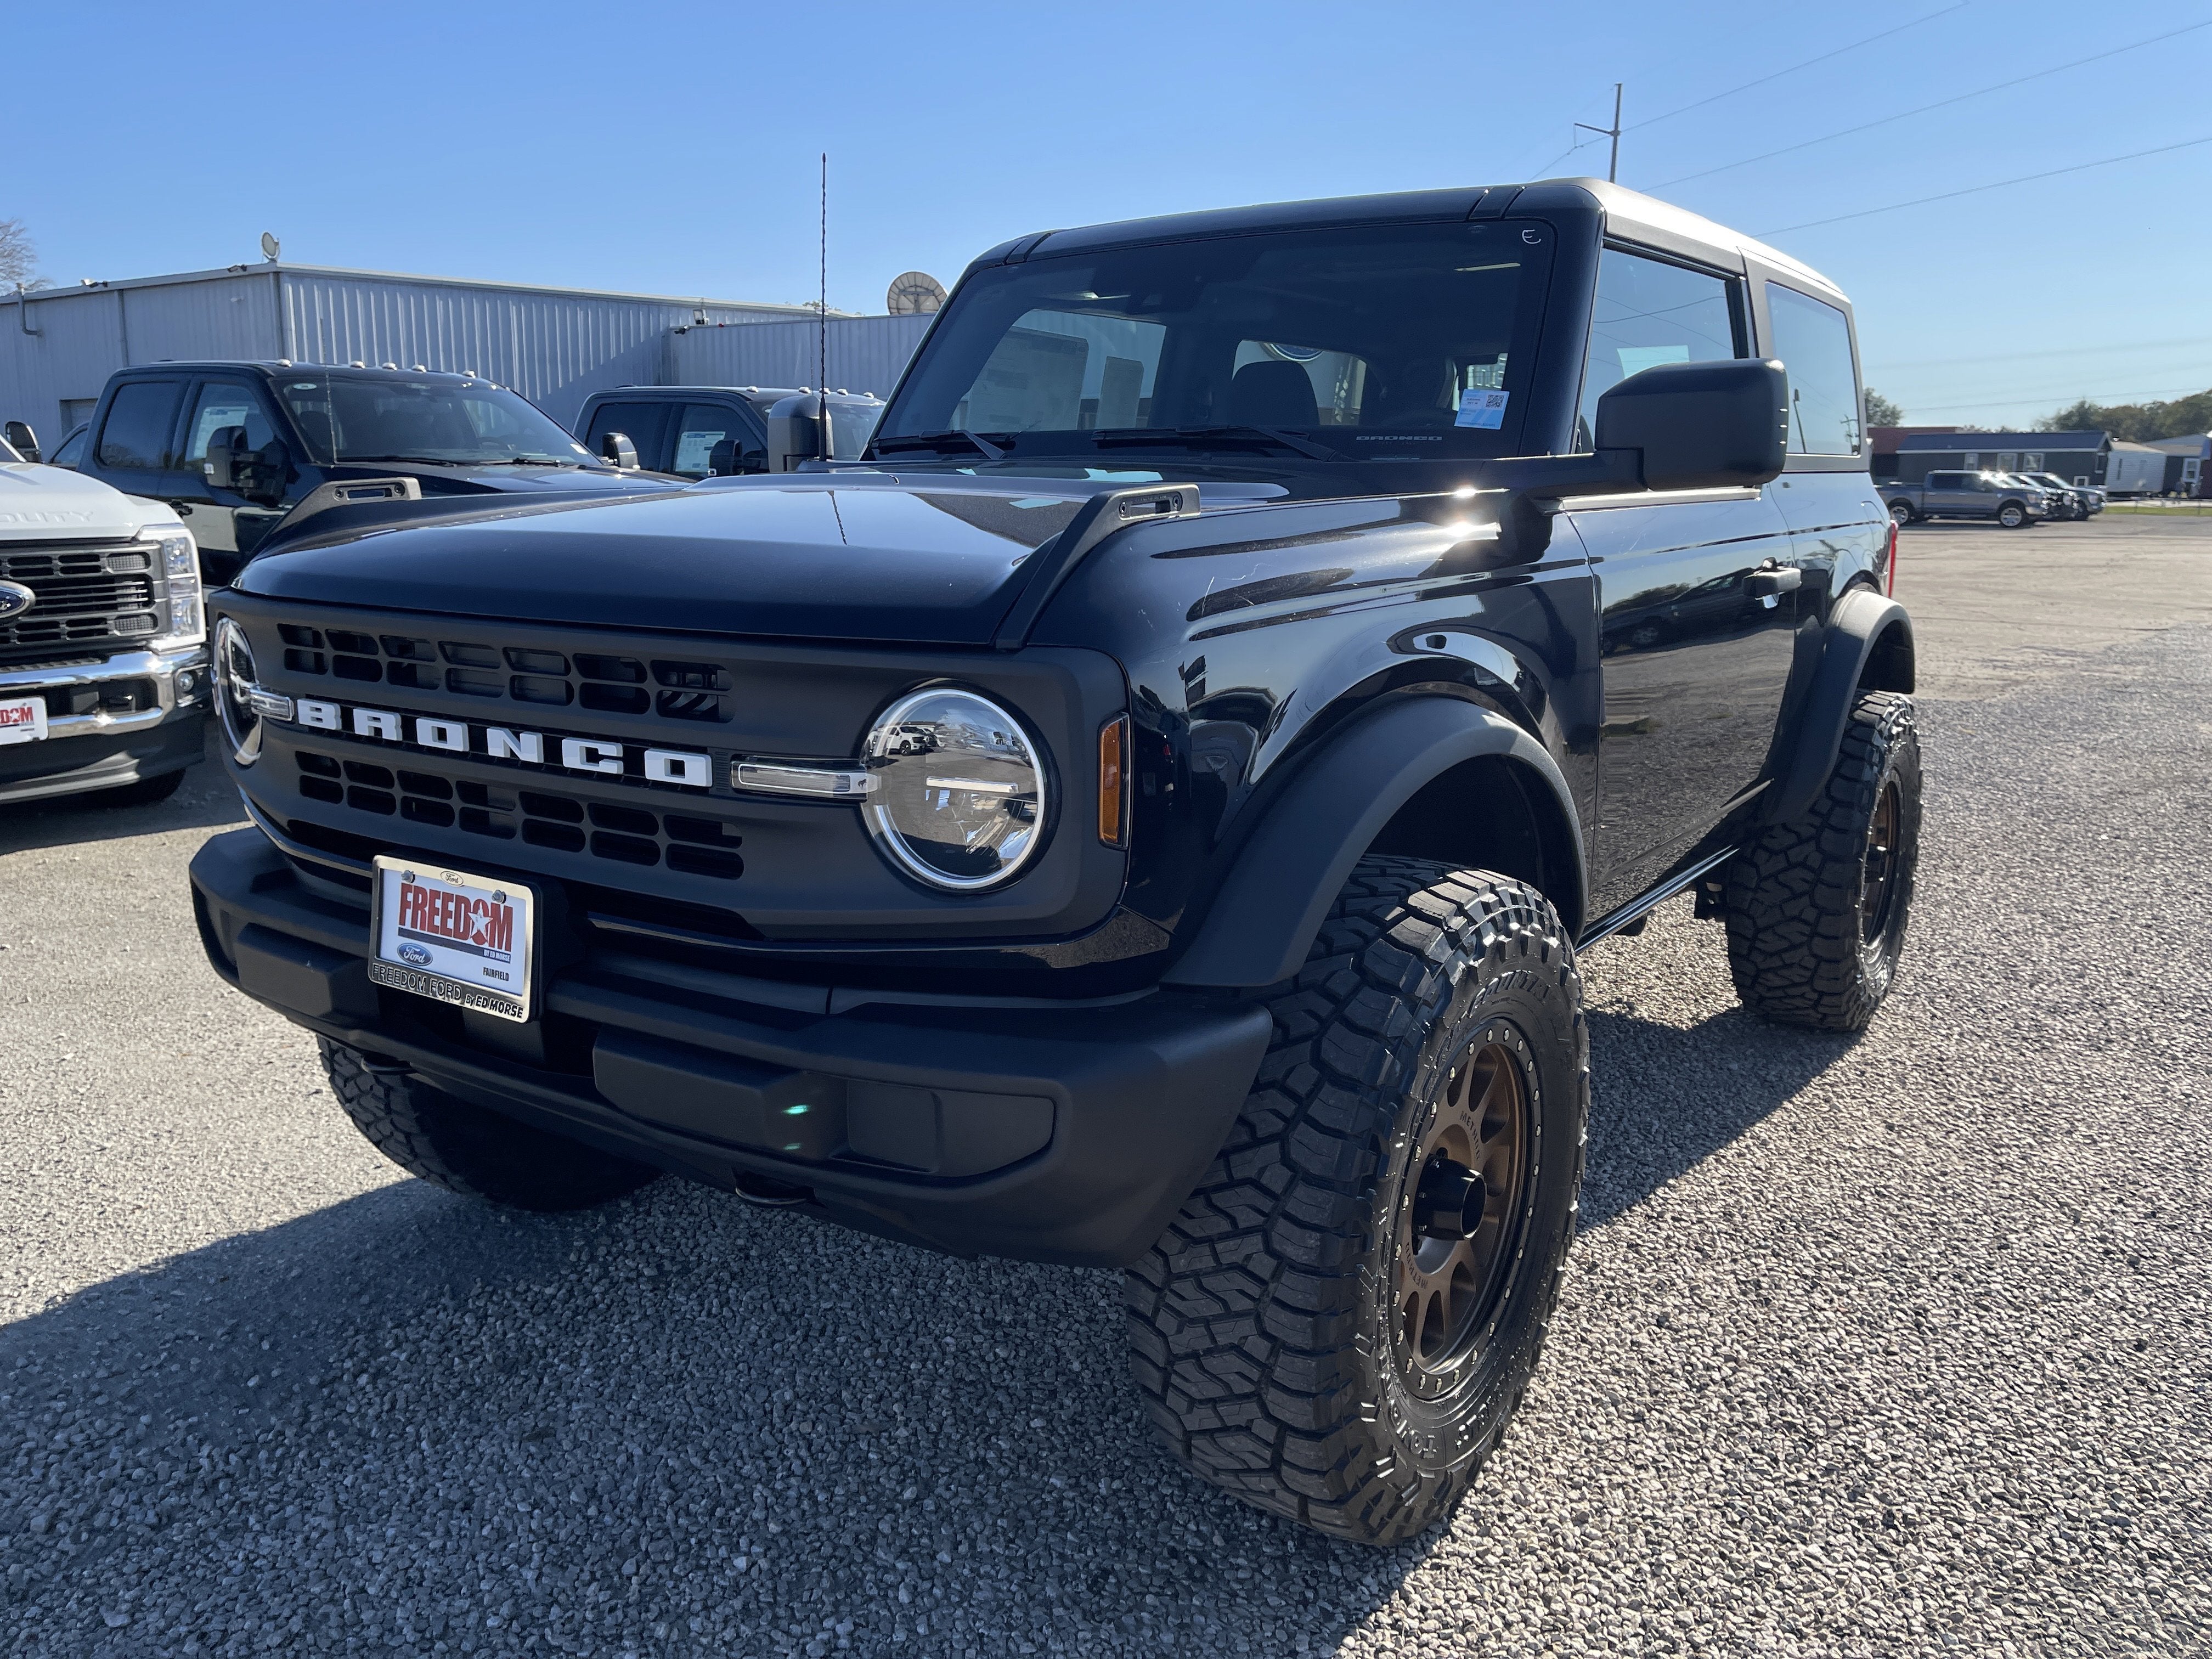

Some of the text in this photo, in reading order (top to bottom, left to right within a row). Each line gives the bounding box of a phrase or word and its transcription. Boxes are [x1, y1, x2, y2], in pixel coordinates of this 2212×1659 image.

[297, 698, 713, 787] BRONCO
[445, 872, 459, 883] Ford
[399, 882, 514, 952] FREEDOM
[403, 946, 426, 963] Ford
[490, 950, 495, 958] ED
[496, 952, 511, 962] MORSE
[483, 966, 510, 982] FAIRFIELD
[371, 962, 427, 994] FREEDOM
[428, 978, 462, 1001] FORD
[475, 994, 488, 1008] ED
[489, 998, 524, 1019] MORSE
